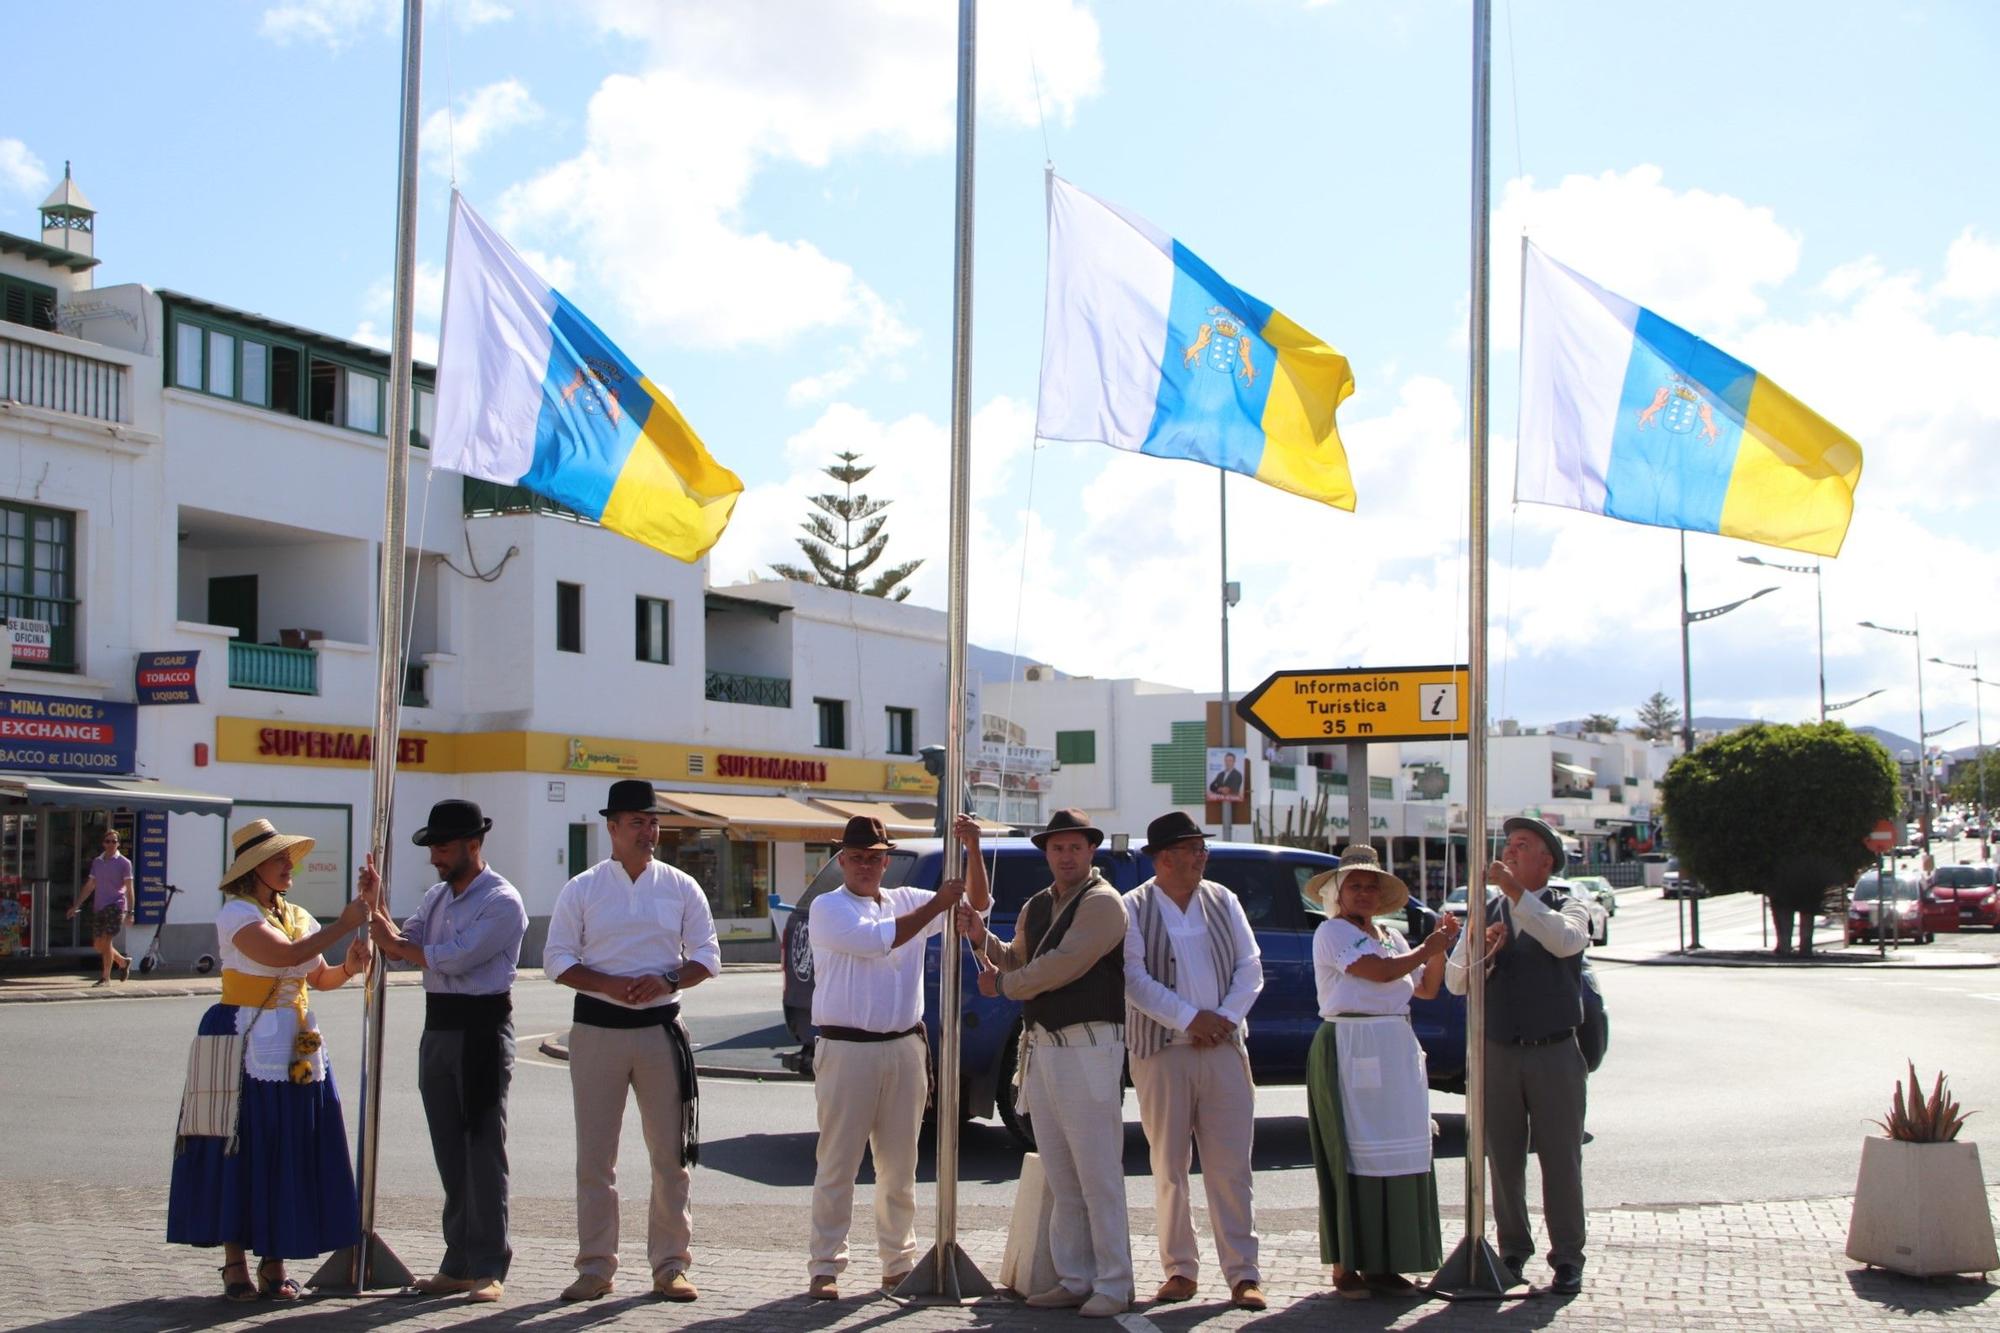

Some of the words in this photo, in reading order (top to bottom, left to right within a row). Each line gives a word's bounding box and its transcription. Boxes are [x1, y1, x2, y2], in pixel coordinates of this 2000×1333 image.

[8, 620, 18, 631] SE
[20, 621, 50, 634] ALQUILA
[15, 632, 45, 644] OFICINA
[153, 656, 187, 666] CIGARS
[146, 672, 190, 683] TOBACCO
[1295, 677, 1399, 695] Información
[151, 690, 190, 702] LIQUORS
[10, 699, 44, 716] MINA
[48, 702, 94, 719] CHOICE
[1307, 698, 1387, 714] Turística
[1, 721, 102, 740] EXCHANGE
[1323, 720, 1346, 734] 35
[1358, 722, 1373, 733] m
[258, 727, 428, 763] SUPERMAET
[63, 752, 118, 768] LIQUORS
[717, 754, 826, 782] SUPERMARKET
[308, 863, 338, 873] ENTRADA
